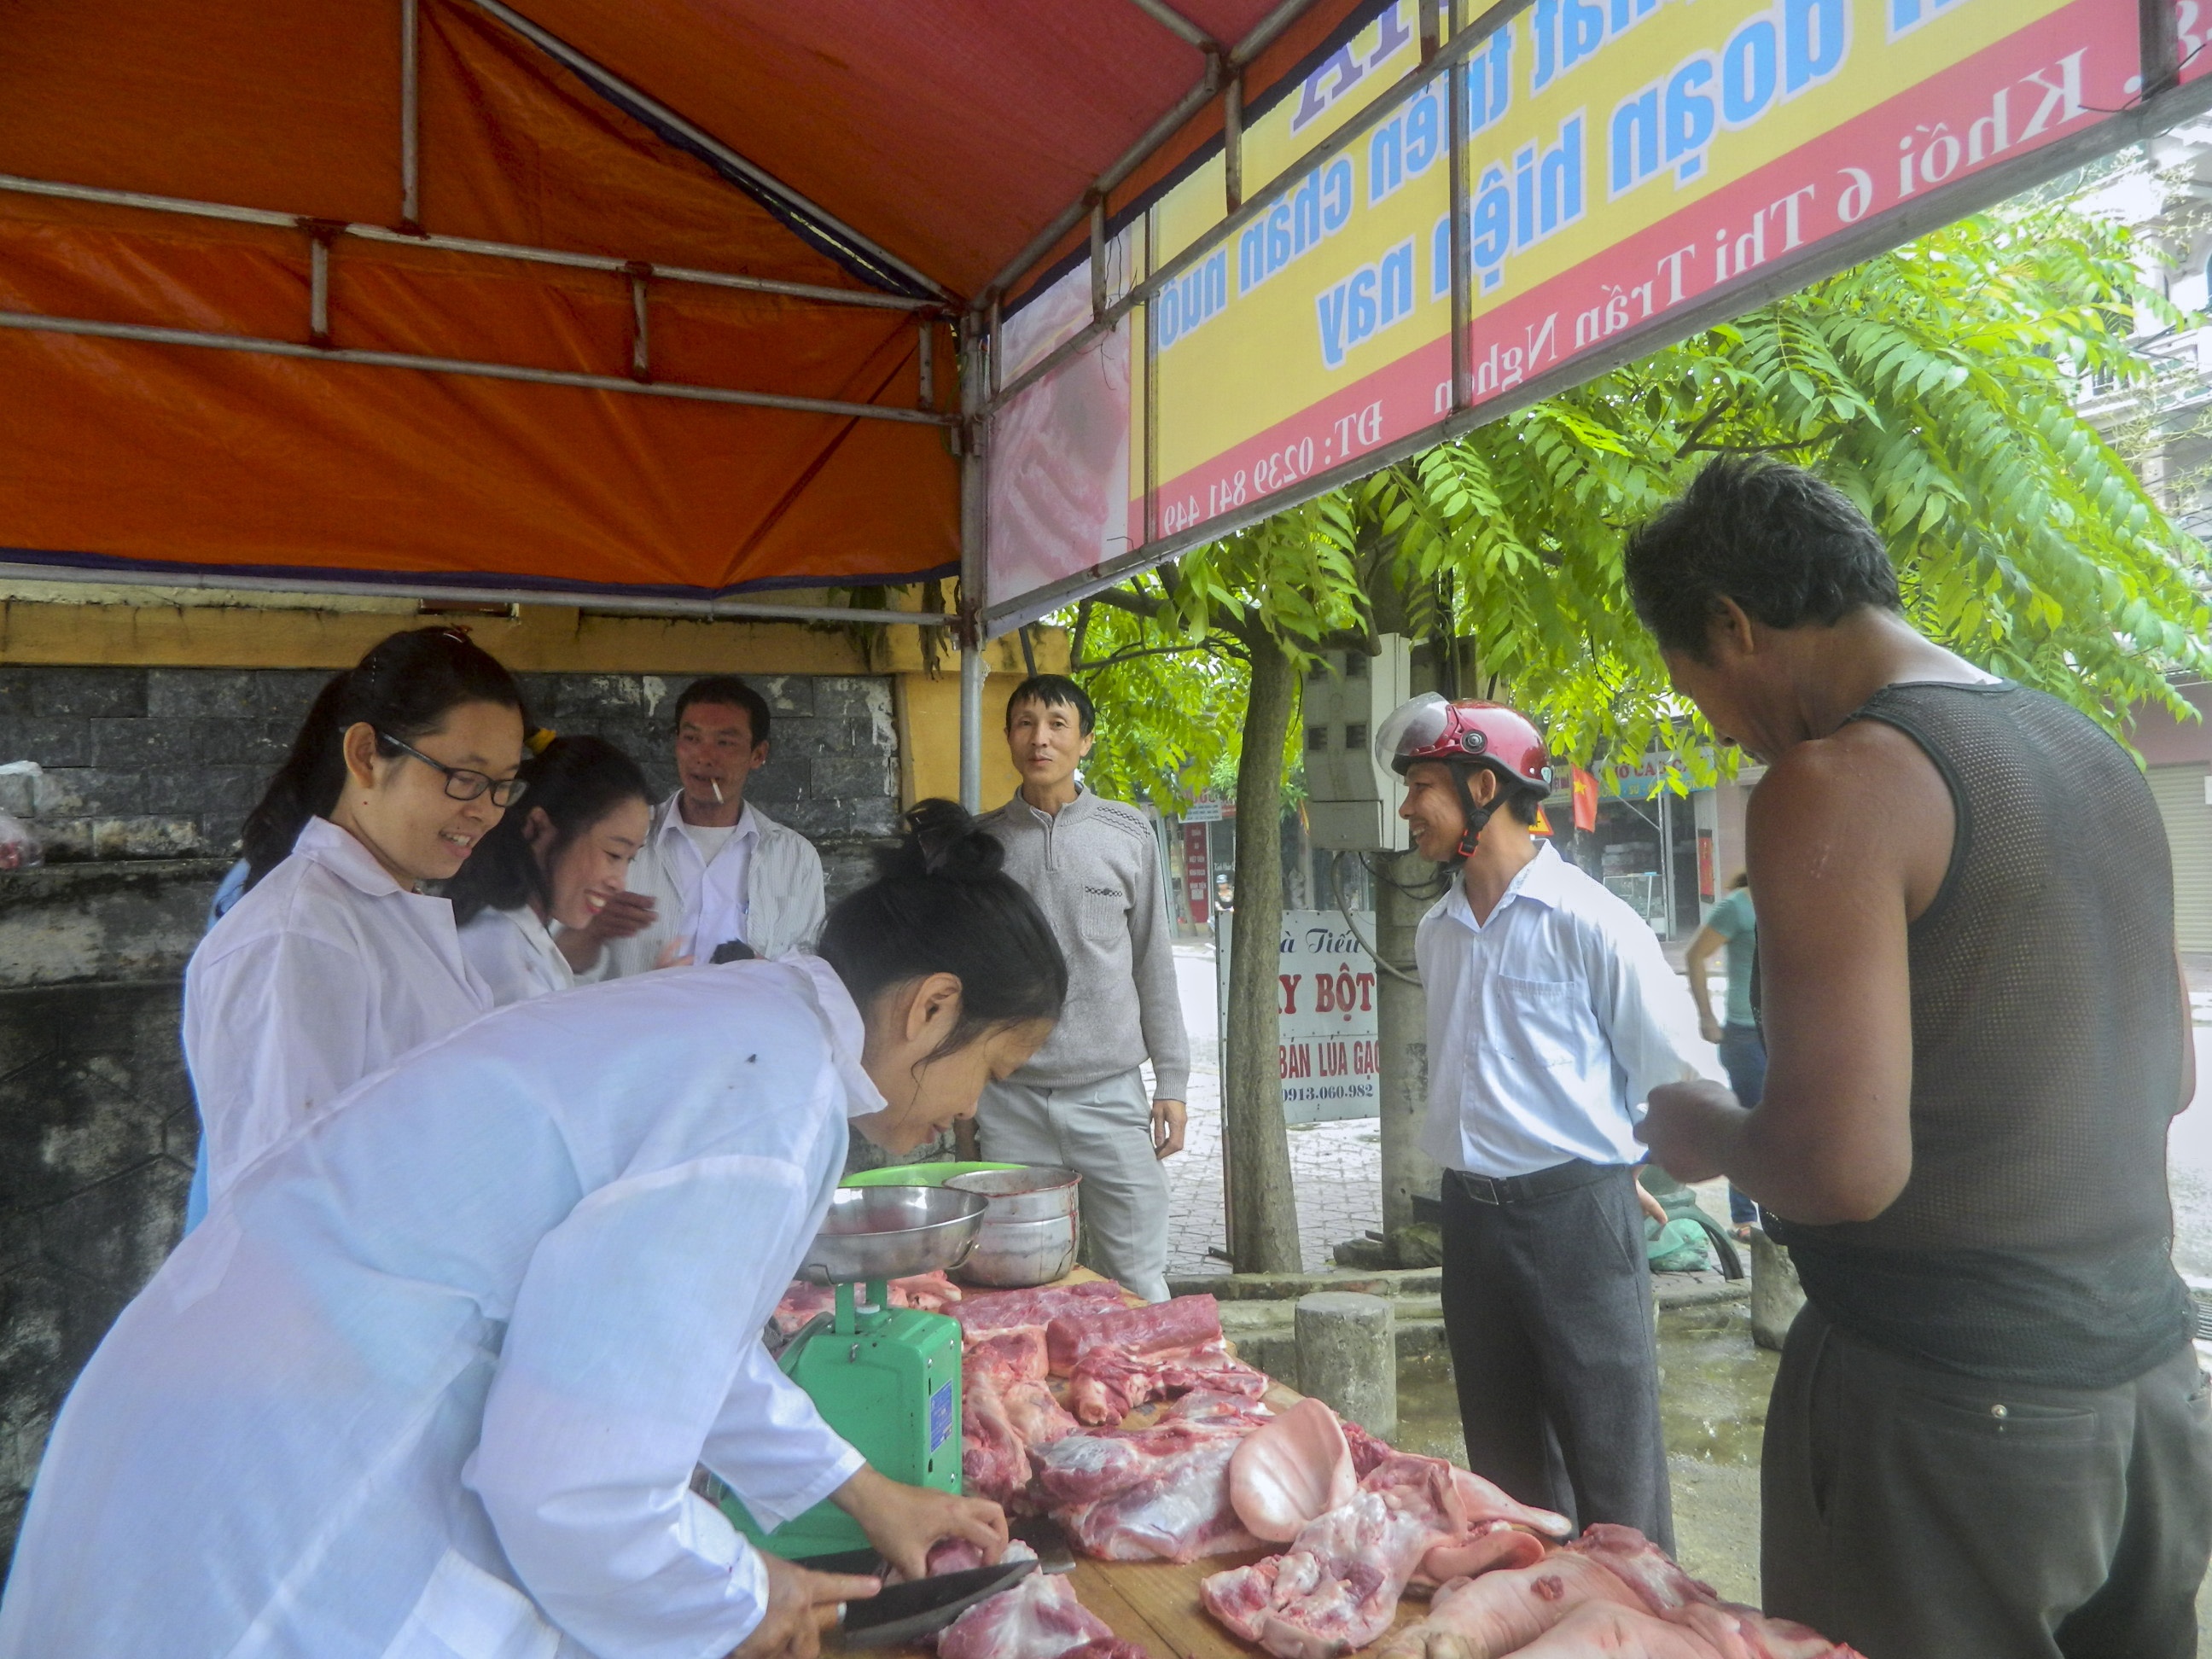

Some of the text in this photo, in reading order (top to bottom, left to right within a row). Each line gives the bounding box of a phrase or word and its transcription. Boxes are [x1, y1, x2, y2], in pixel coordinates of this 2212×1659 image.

[1315, 962, 1375, 1022] BỘT
[1279, 1036, 1312, 1080] BÁN
[1318, 1033, 1348, 1077] LÚA
